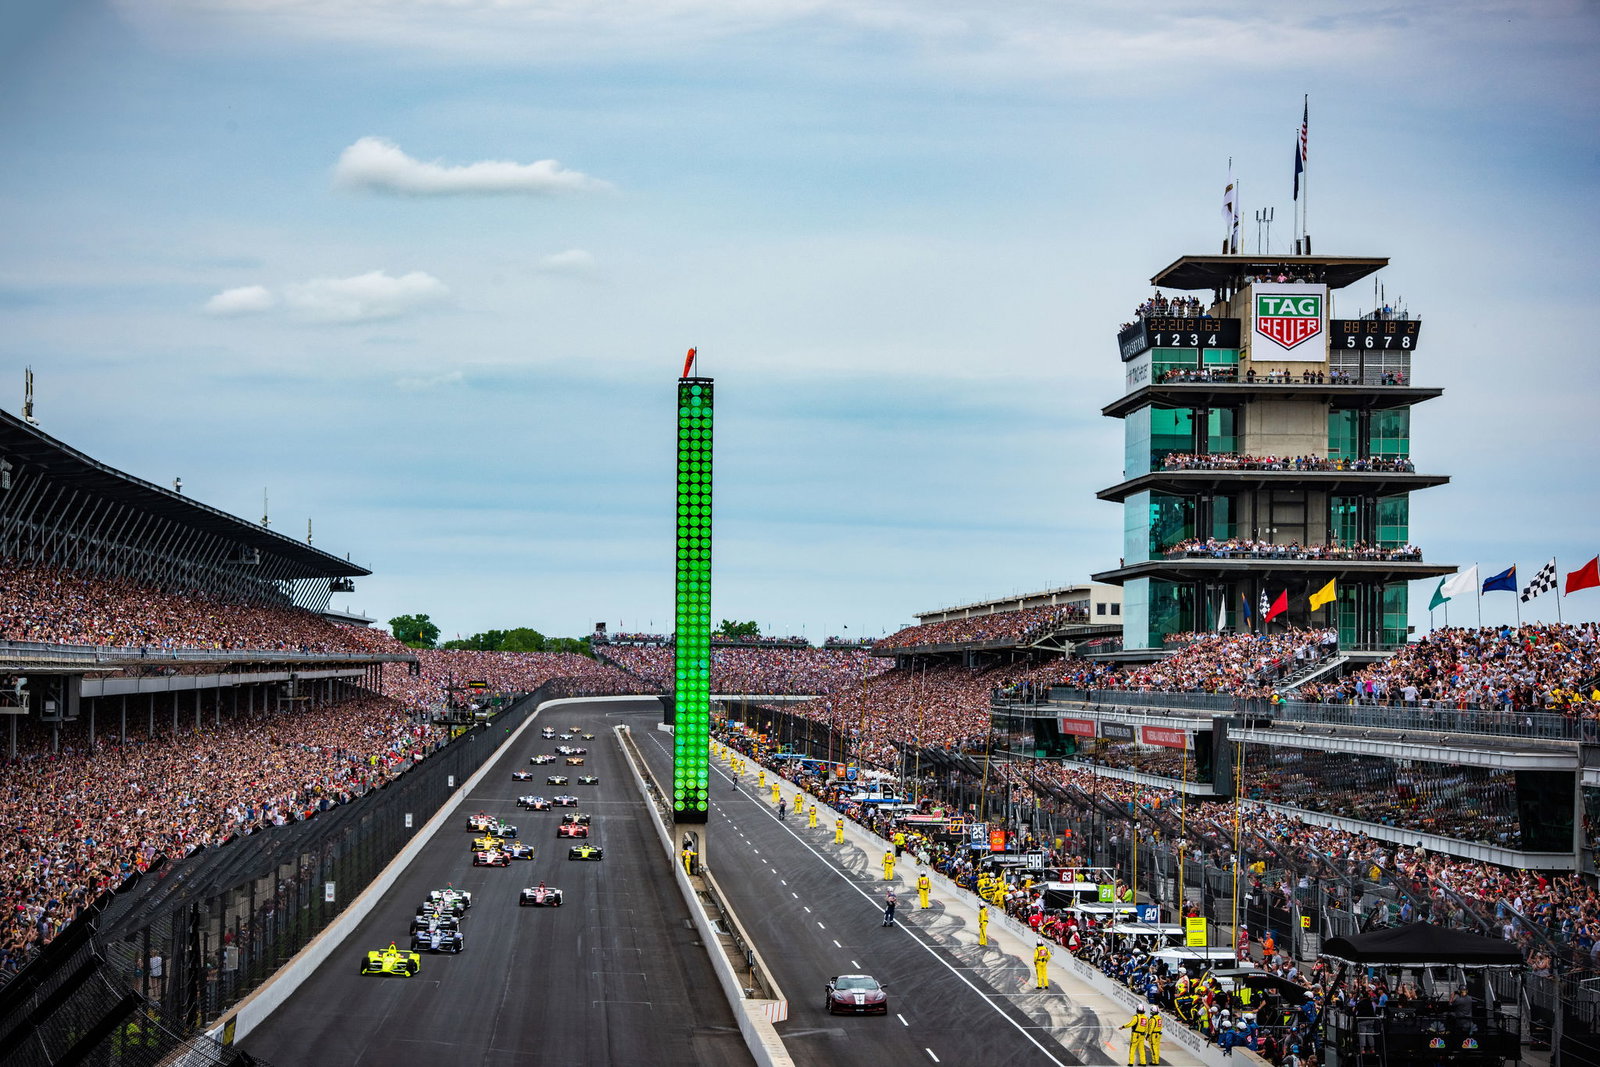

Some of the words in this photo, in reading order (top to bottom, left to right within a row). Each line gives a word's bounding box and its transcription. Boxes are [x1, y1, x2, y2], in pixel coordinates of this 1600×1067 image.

[1262, 298, 1315, 315] TAG
[1261, 319, 1317, 345] HEUER
[1366, 321, 1378, 333] 12
[1385, 321, 1397, 333] 18
[1407, 321, 1415, 334] 2
[1154, 333, 1161, 346] 1
[1171, 333, 1180, 346] 2
[1190, 333, 1198, 346] 3
[1207, 334, 1216, 346] 4
[1347, 335, 1355, 348] 5
[1365, 335, 1374, 348] 6
[1383, 336, 1392, 348] 7
[1401, 336, 1411, 348] 8
[951, 819, 963, 832] 27
[972, 825, 985, 840] 25
[1028, 854, 1041, 869] 98
[1062, 871, 1072, 881] 63
[1102, 888, 1111, 898] 21
[1144, 908, 1158, 921] 20
